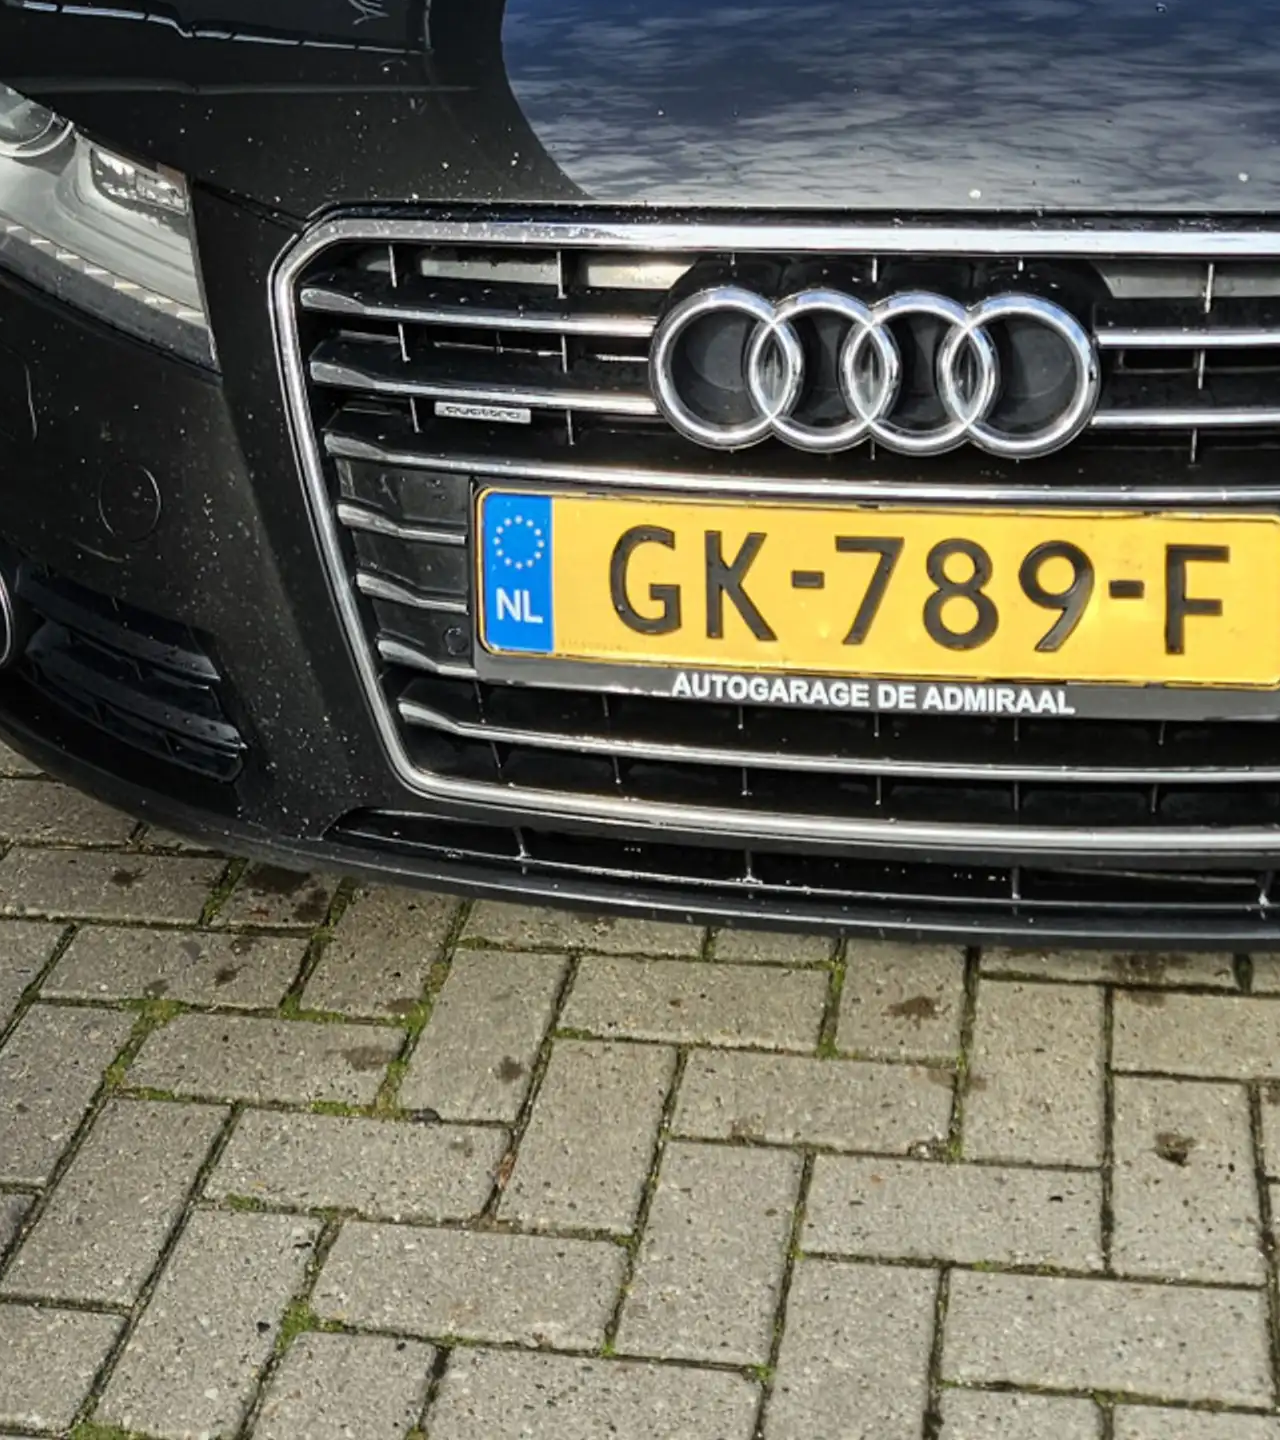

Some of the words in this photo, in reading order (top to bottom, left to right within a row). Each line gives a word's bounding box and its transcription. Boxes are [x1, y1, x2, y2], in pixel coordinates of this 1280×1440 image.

[495, 588, 543, 624] NL
[609, 524, 1230, 656] GK-789-F
[671, 671, 869, 708] AUTOGARAGE
[877, 684, 917, 709] DE
[922, 685, 1075, 715] ADMIRAAL
